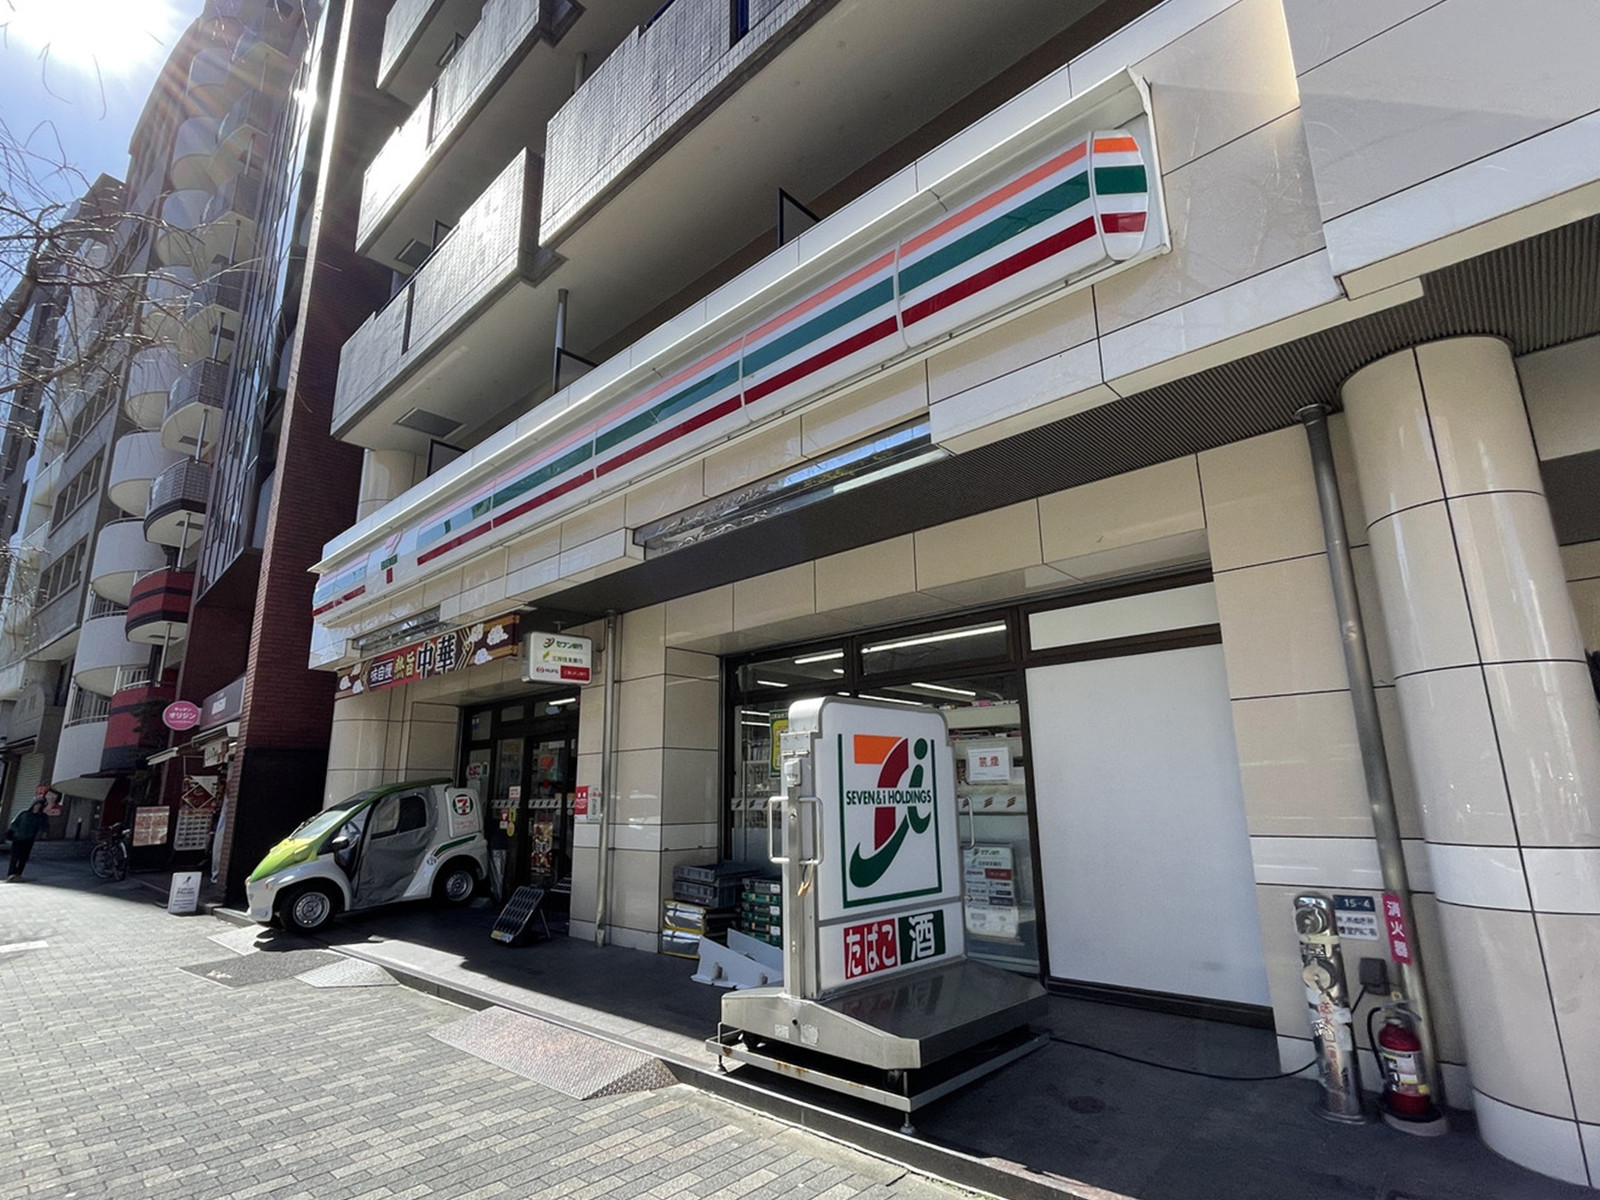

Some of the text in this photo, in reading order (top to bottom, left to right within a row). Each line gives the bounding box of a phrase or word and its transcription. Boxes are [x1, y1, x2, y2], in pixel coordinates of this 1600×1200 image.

[888, 789, 932, 804] HOLDINGS
[1344, 899, 1371, 908] 15-4
[846, 923, 896, 977] たばこ
[909, 913, 935, 961] 酒
[1386, 900, 1409, 958] 消火器
